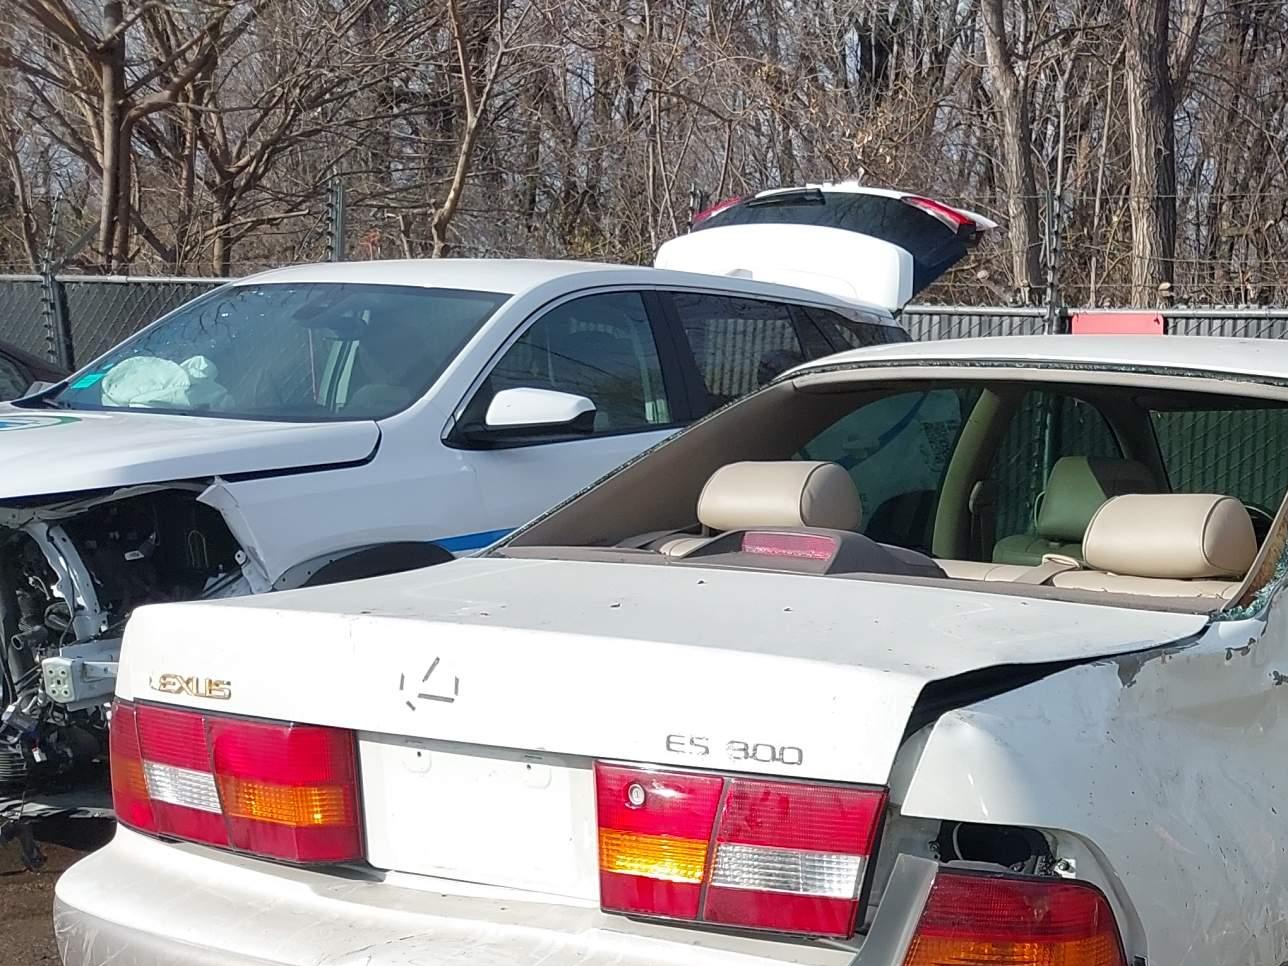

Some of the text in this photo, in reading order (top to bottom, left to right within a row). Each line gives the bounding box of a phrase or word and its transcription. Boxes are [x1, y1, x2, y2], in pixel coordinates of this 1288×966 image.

[149, 673, 232, 700] LEXUS
[666, 734, 803, 765] ES 300
